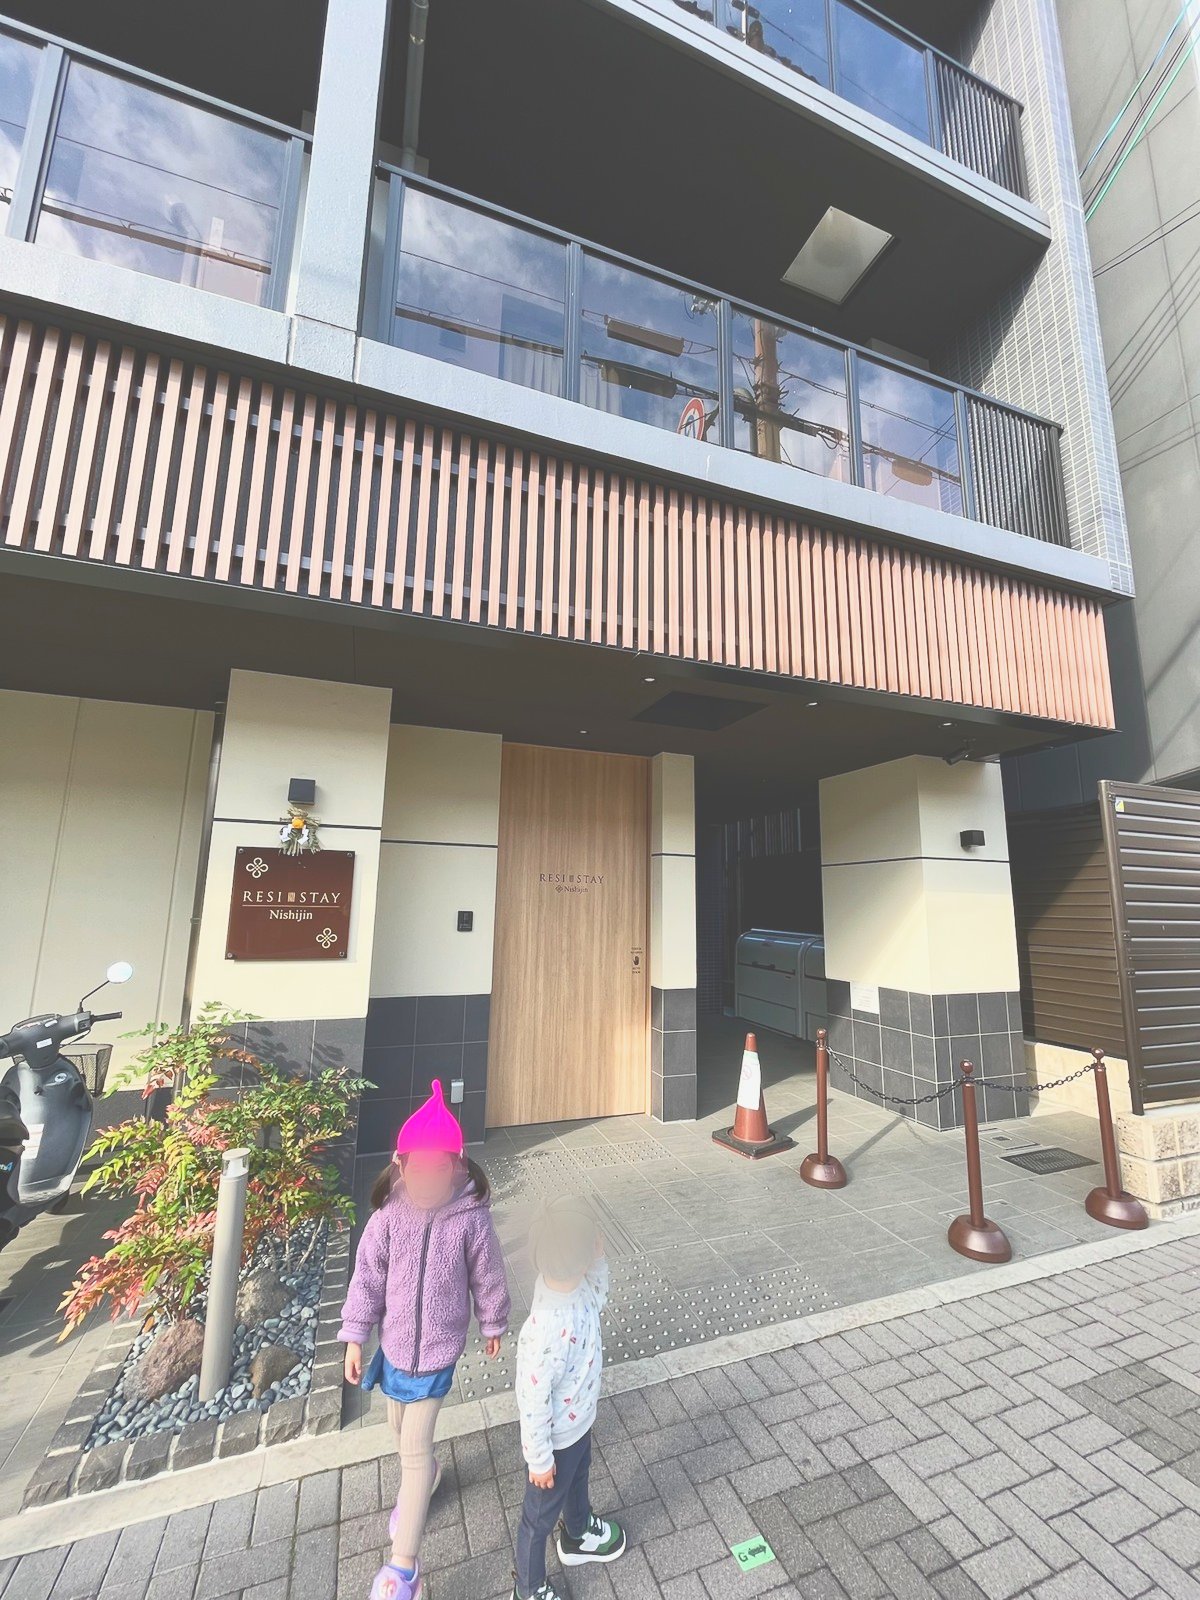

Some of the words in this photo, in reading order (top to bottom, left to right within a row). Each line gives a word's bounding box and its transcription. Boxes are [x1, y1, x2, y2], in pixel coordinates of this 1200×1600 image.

[539, 873, 565, 883] RESI
[576, 874, 604, 884] STAY
[243, 890, 282, 903] RESI
[299, 891, 341, 904] STAY
[269, 909, 313, 922] Nishijin
[738, 1552, 749, 1562] G
